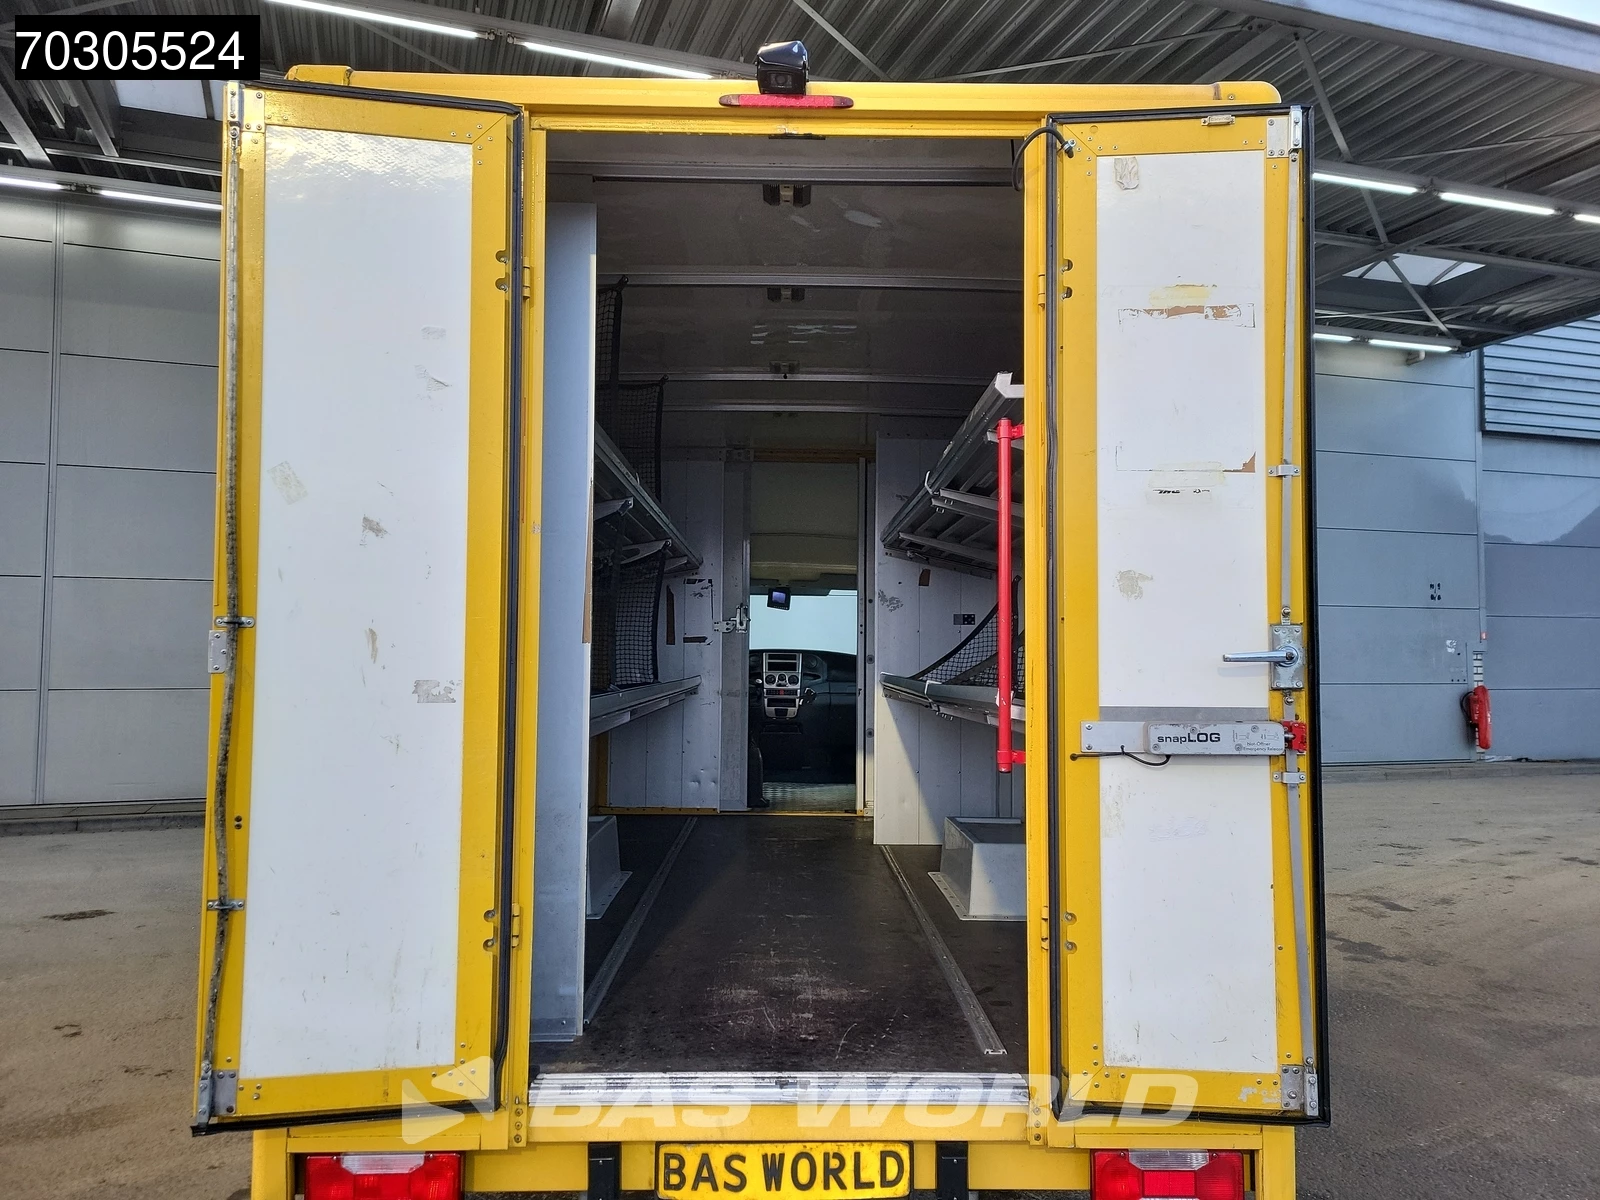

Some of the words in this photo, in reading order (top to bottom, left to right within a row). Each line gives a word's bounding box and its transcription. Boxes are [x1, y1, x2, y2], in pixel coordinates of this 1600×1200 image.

[1157, 732, 1221, 745] snapLOG
[663, 1152, 748, 1193] BAS
[762, 1150, 905, 1192] WORLD
